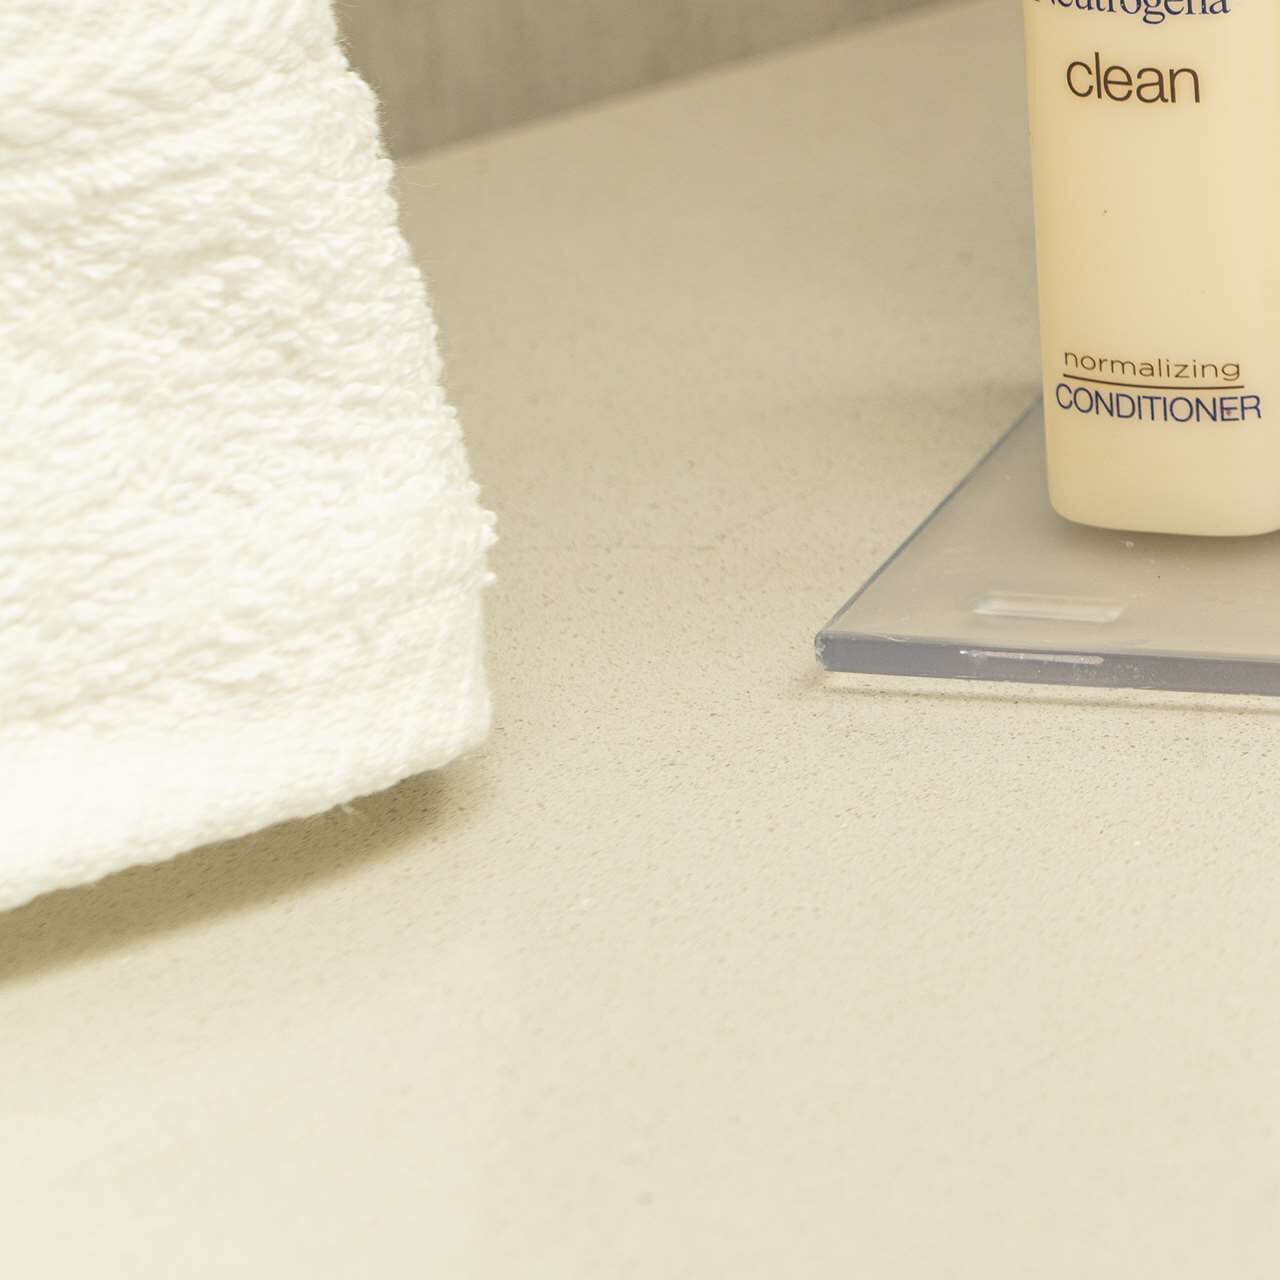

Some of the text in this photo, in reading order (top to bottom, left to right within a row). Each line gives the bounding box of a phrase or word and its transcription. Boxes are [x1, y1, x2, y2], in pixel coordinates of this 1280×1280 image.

[1066, 51, 1200, 104] clean
[1064, 349, 1241, 381] normalizing
[1055, 383, 1262, 422] CONDITIONER
